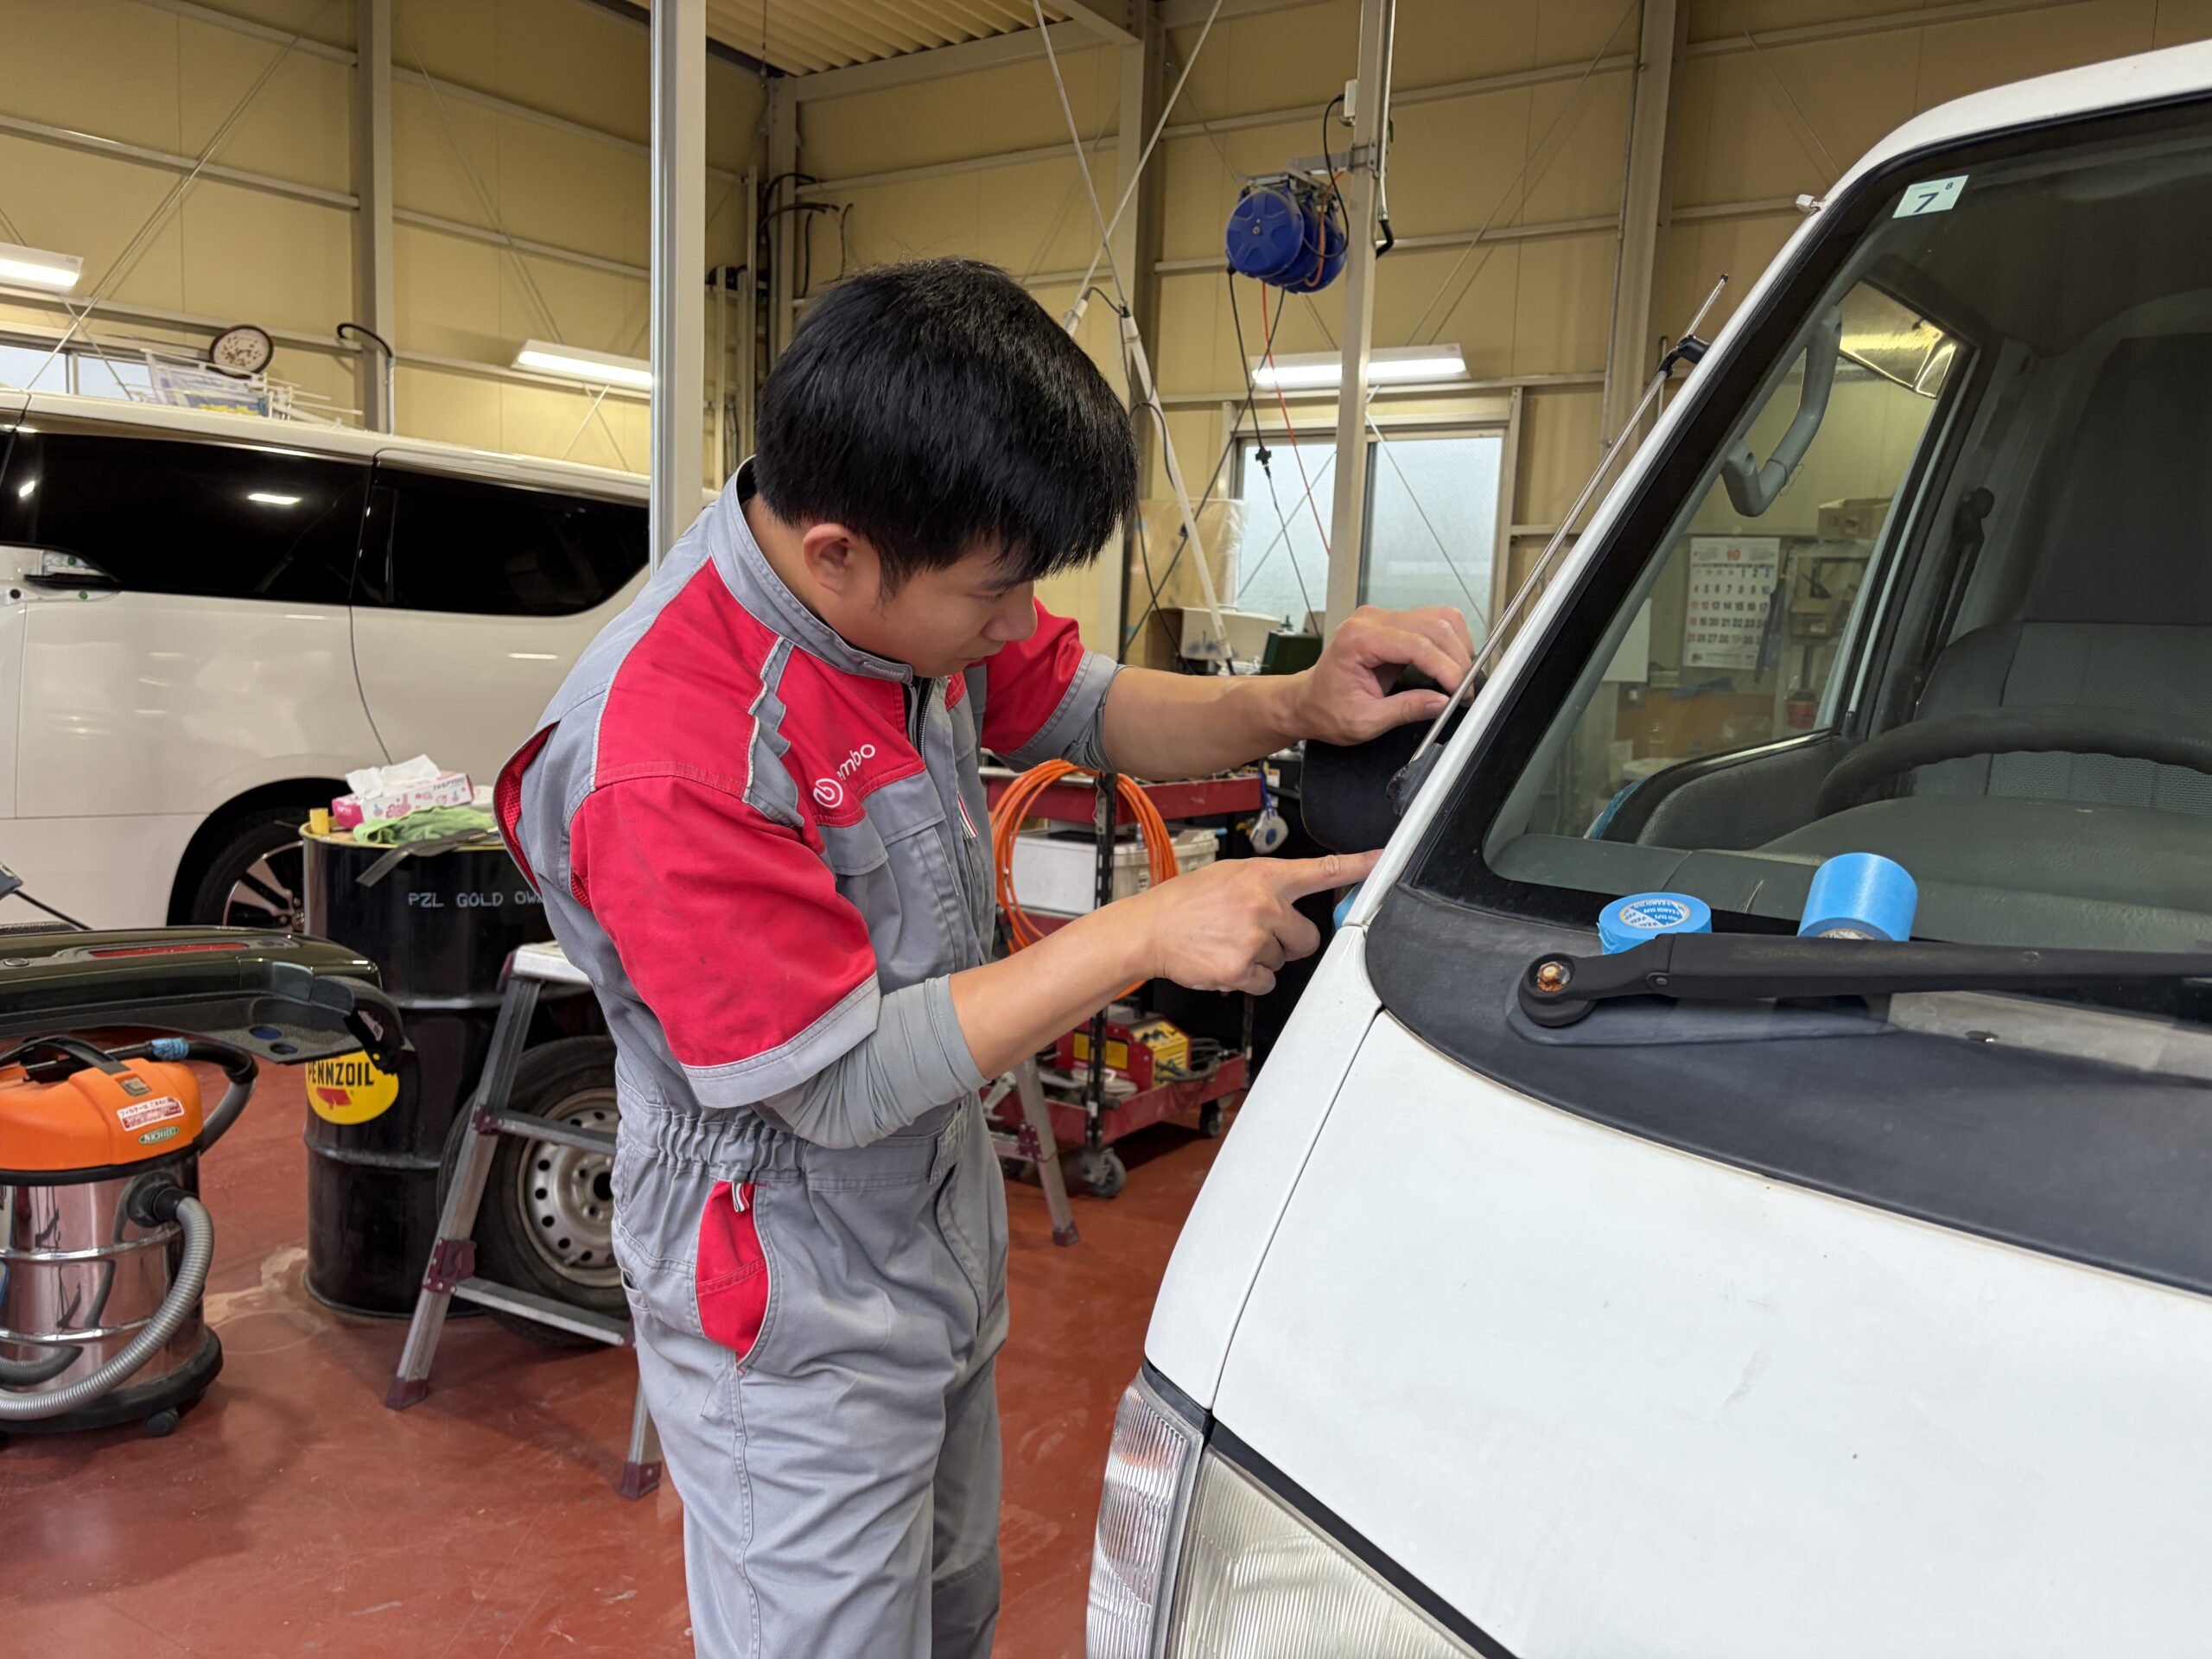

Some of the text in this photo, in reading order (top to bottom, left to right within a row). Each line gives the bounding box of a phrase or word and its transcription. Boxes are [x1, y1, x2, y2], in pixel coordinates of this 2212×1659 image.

[1913, 191, 1940, 213] 7
[836, 743, 876, 780] mbo
[408, 892, 444, 908] PZL
[455, 891, 504, 908] GOLD
[307, 1061, 375, 1087] PENNZOIL
